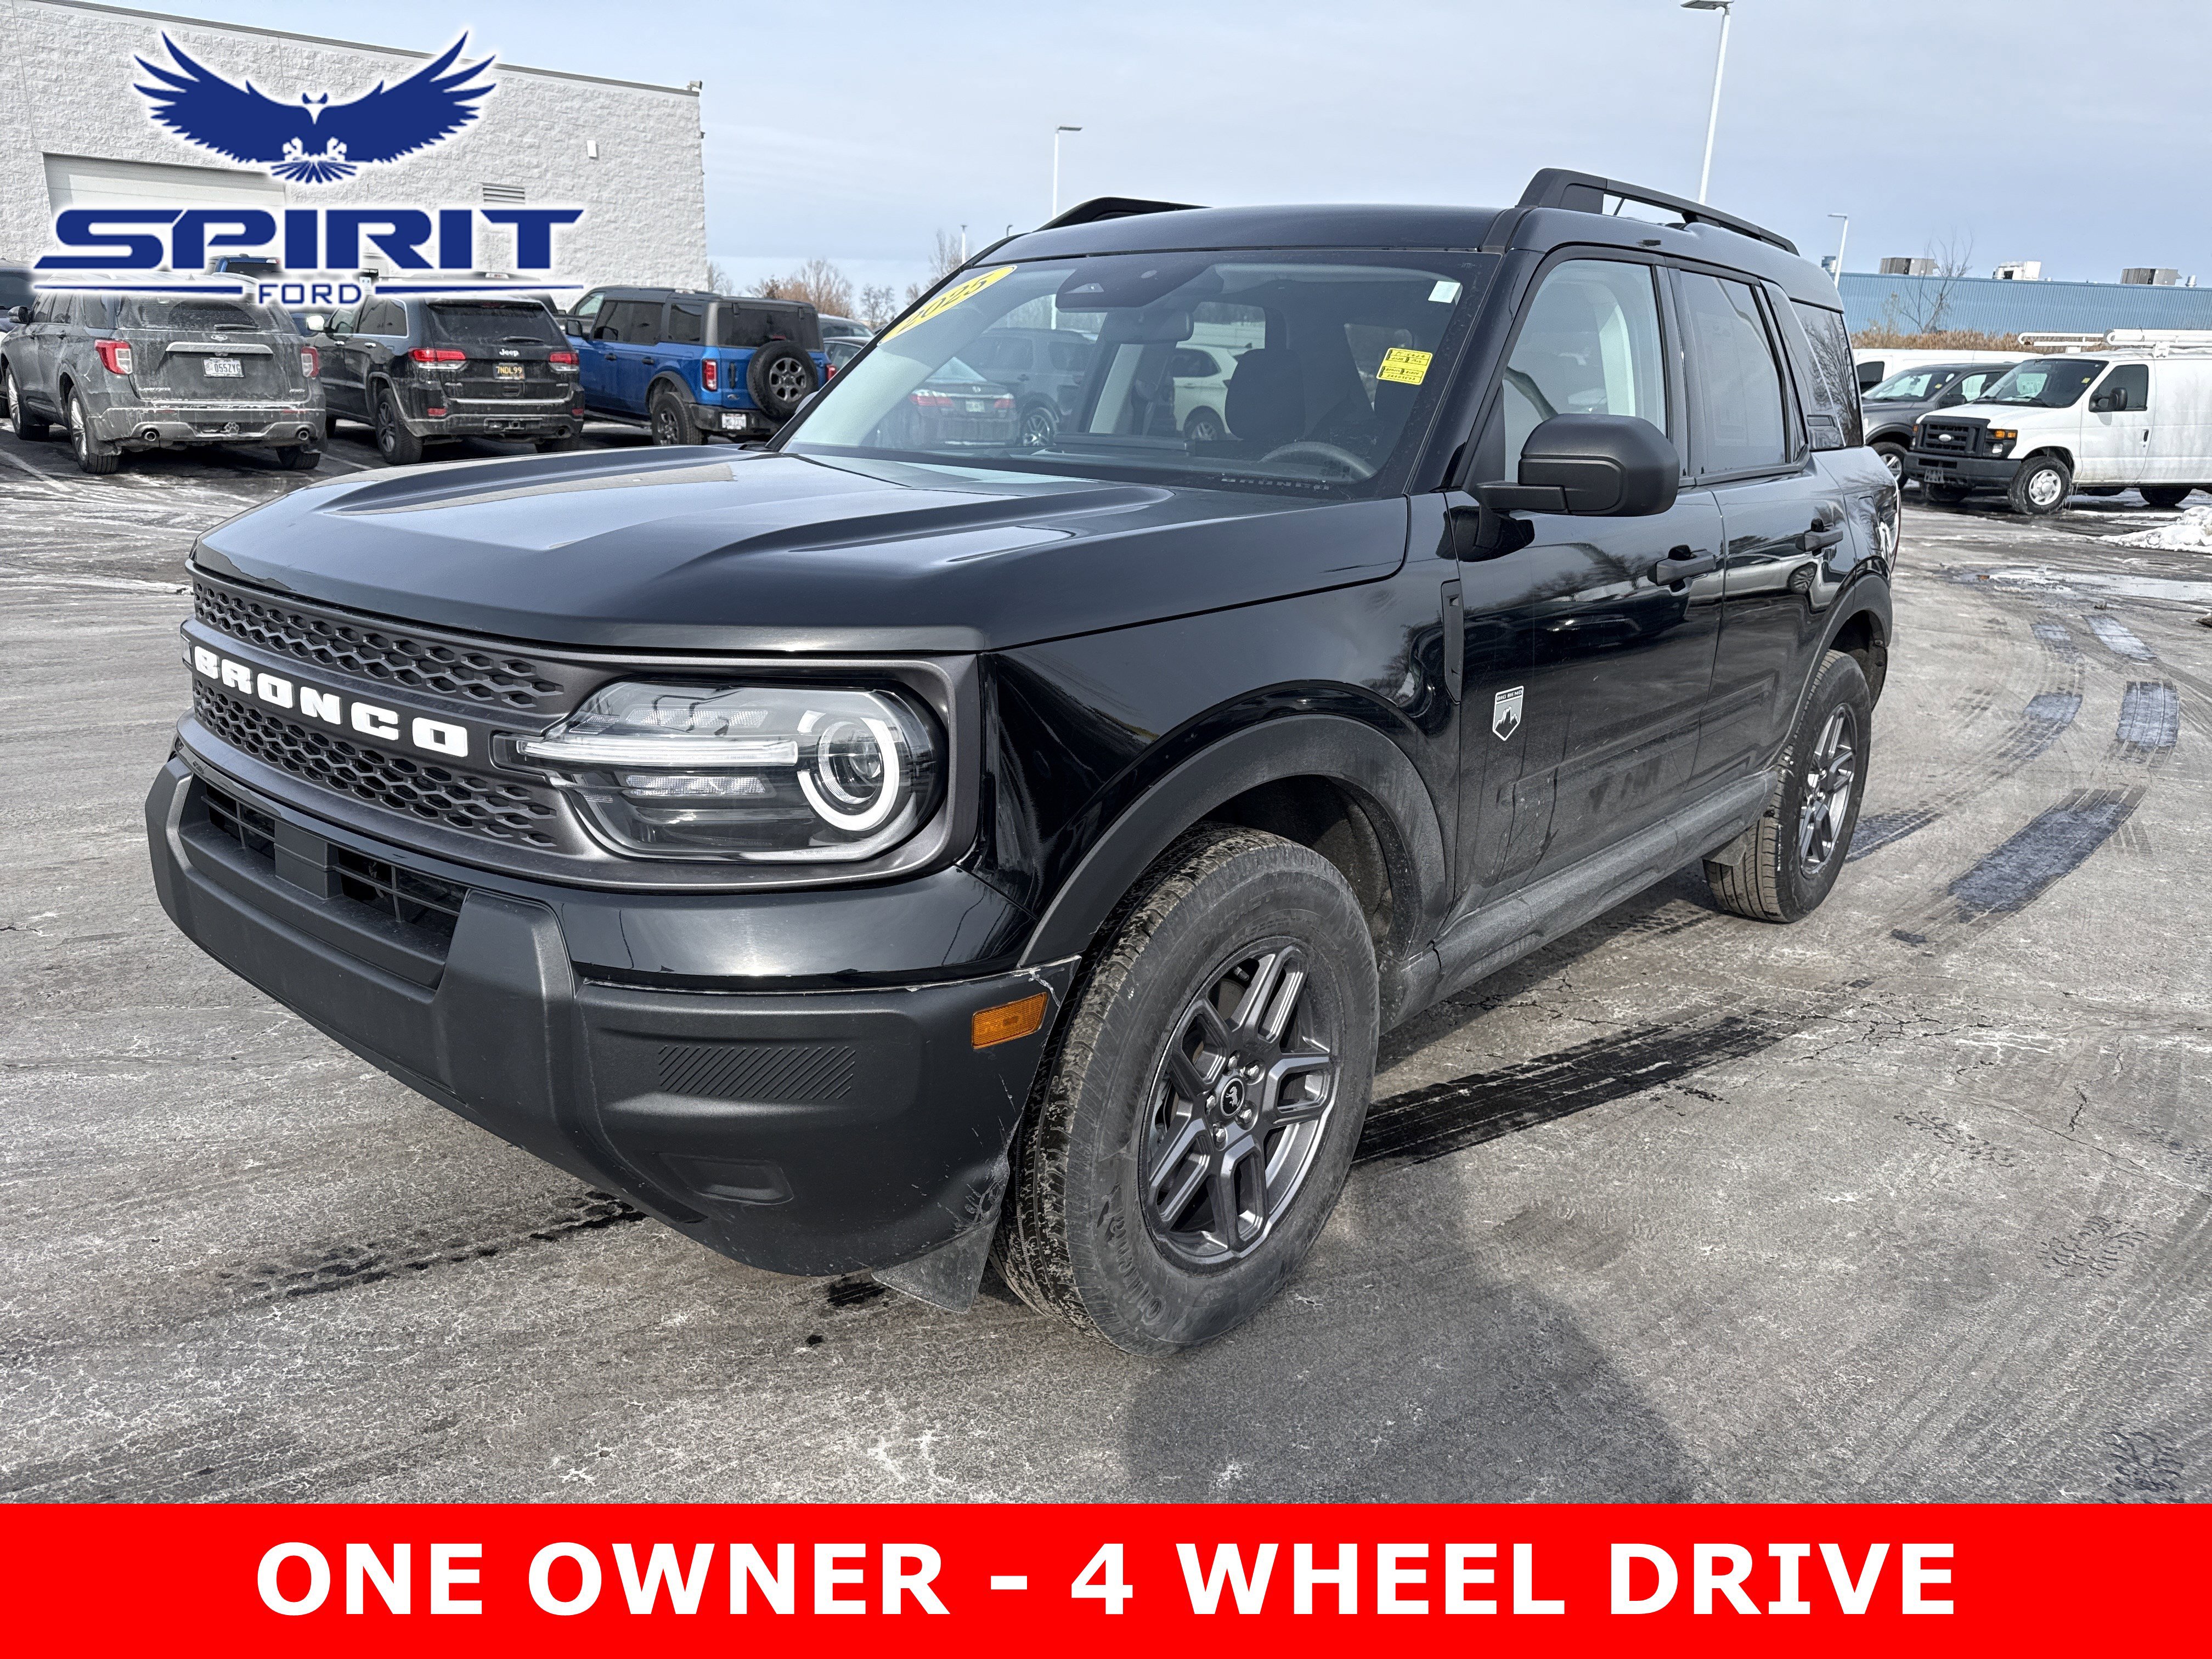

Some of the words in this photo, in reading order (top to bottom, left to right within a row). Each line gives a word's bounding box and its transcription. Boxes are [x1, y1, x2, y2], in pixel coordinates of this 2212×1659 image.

[896, 273, 994, 334] 2025
[499, 348, 520, 357] Jeep
[194, 646, 467, 758] BRONCO
[1507, 690, 1522, 698] BEND
